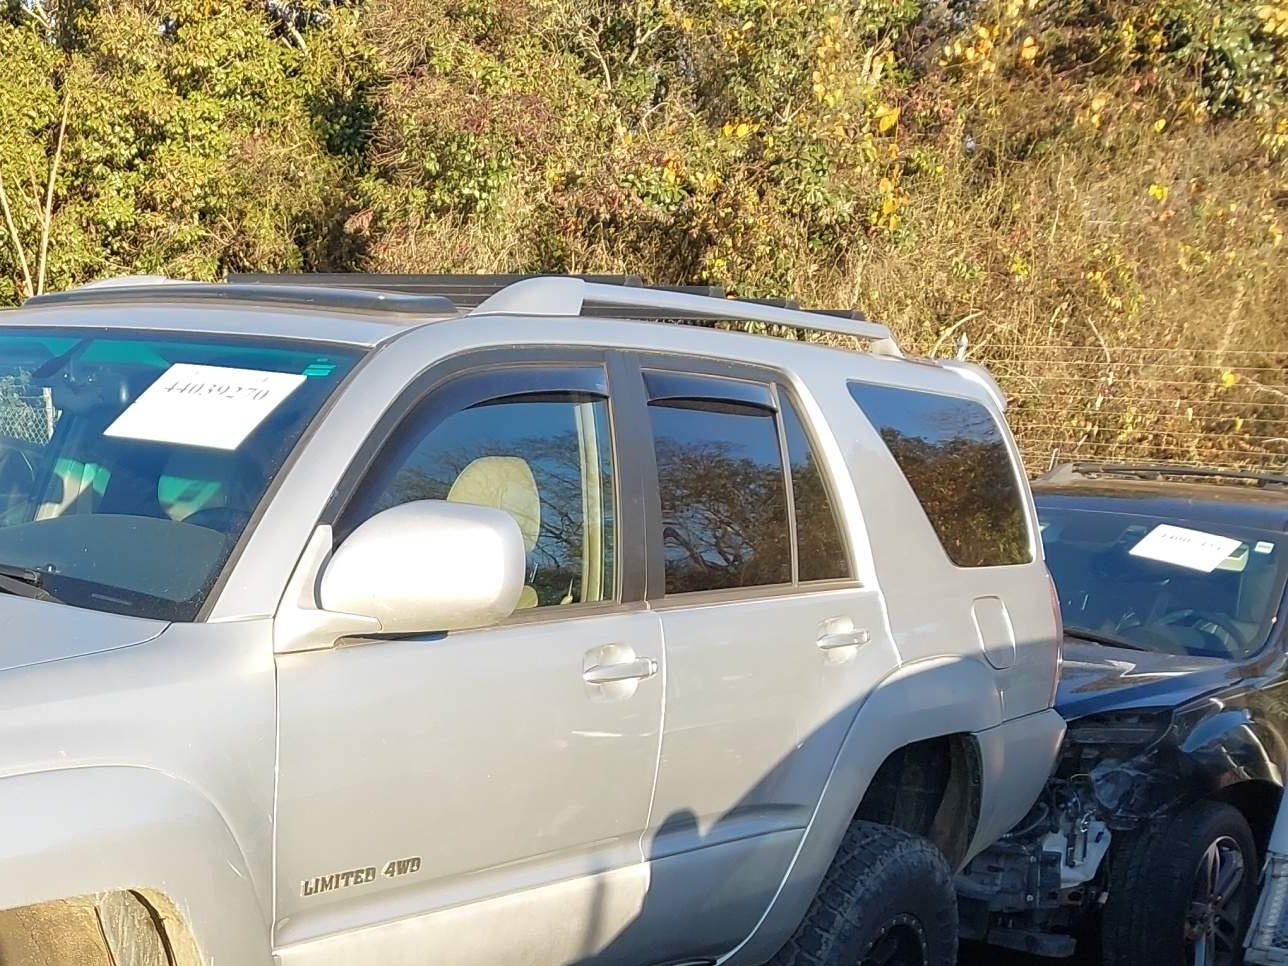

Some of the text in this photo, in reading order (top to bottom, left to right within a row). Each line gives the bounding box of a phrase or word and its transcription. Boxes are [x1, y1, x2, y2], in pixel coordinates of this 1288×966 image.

[162, 380, 271, 402] 44039270
[302, 856, 422, 897] LIMITED 4WD
